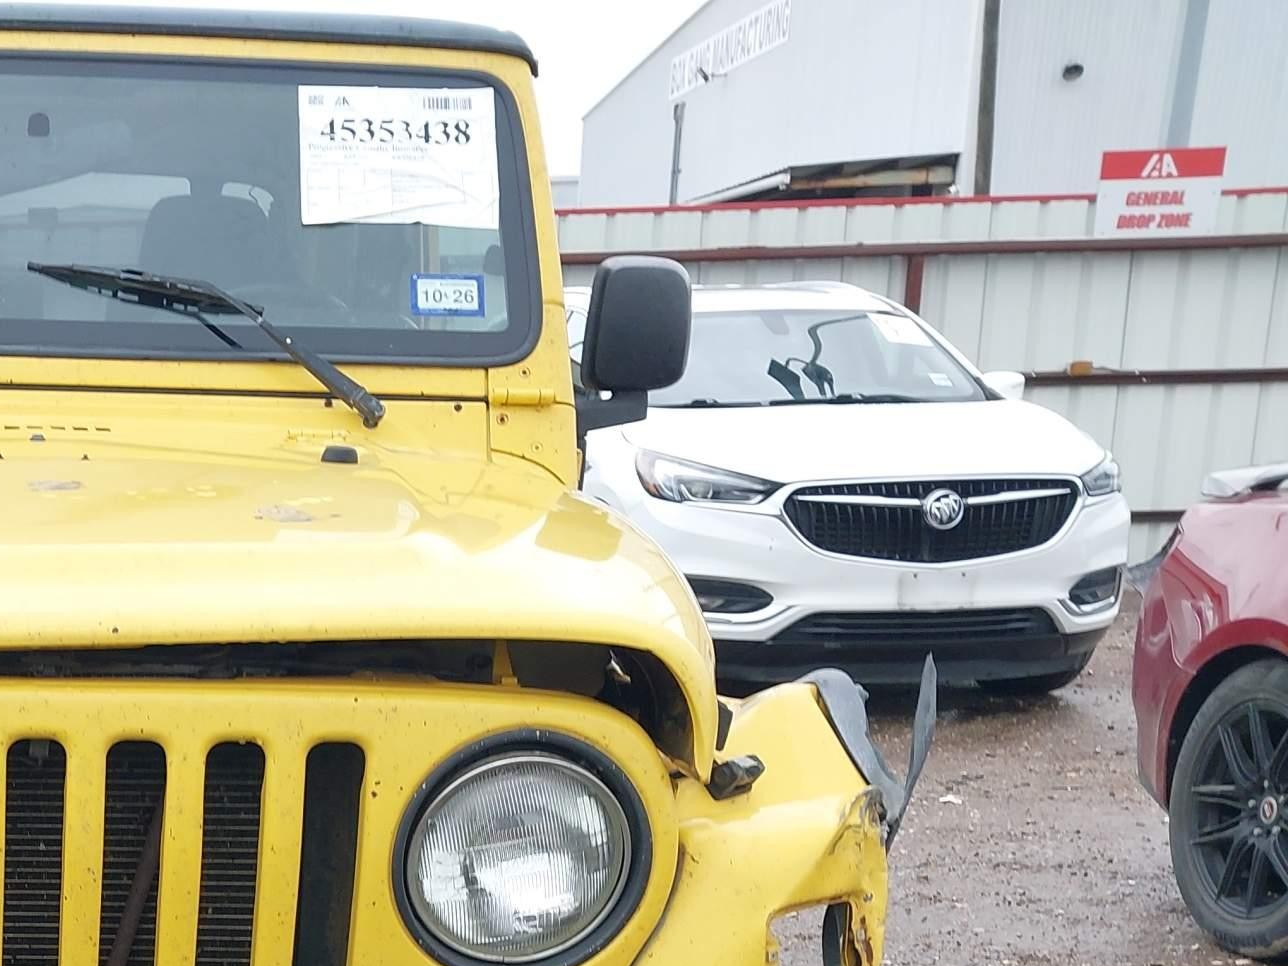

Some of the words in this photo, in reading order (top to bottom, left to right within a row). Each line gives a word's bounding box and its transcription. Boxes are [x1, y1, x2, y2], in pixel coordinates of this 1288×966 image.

[320, 118, 471, 145] 45353438
[1125, 190, 1185, 206] GENERAL
[1116, 213, 1155, 229] DROP
[1157, 212, 1192, 228] ZONE
